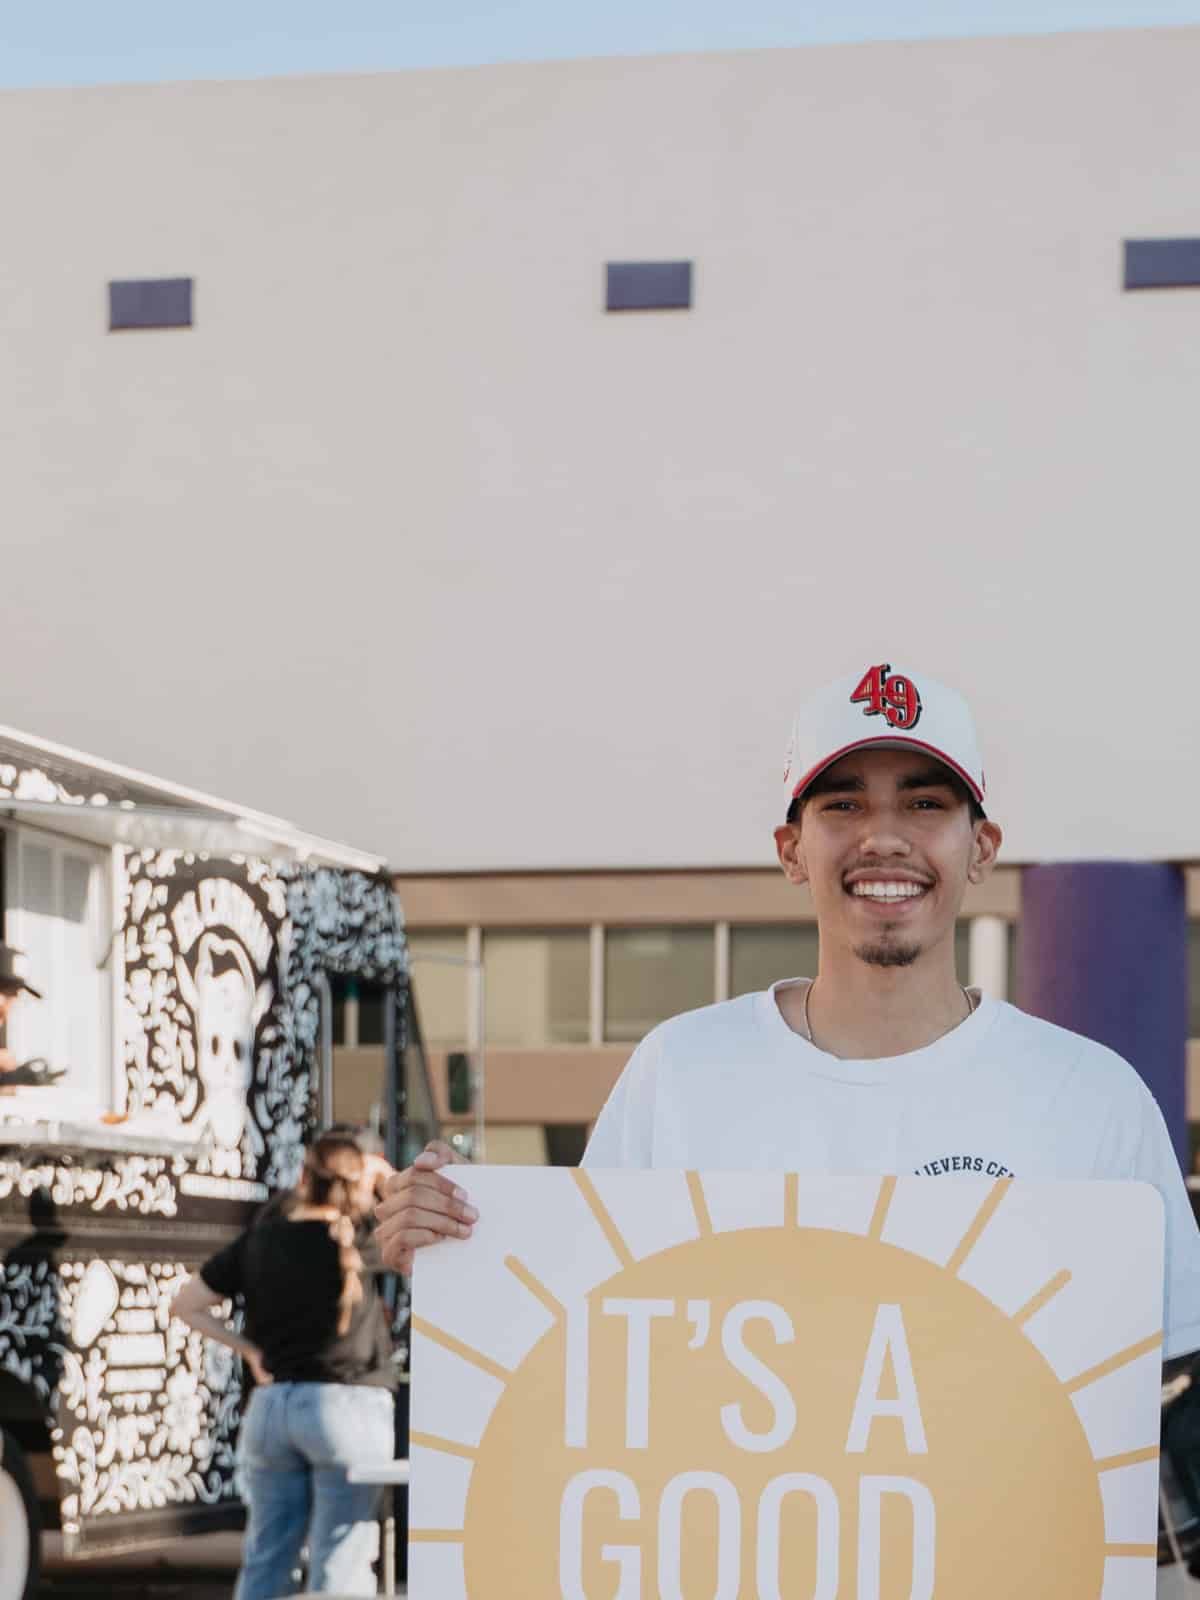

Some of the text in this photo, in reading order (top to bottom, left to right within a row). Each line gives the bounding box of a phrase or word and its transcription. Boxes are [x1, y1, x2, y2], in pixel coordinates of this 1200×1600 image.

[850, 664, 922, 730] 49
[914, 1155, 984, 1177] IEVERS
[845, 1303, 929, 1455] A
